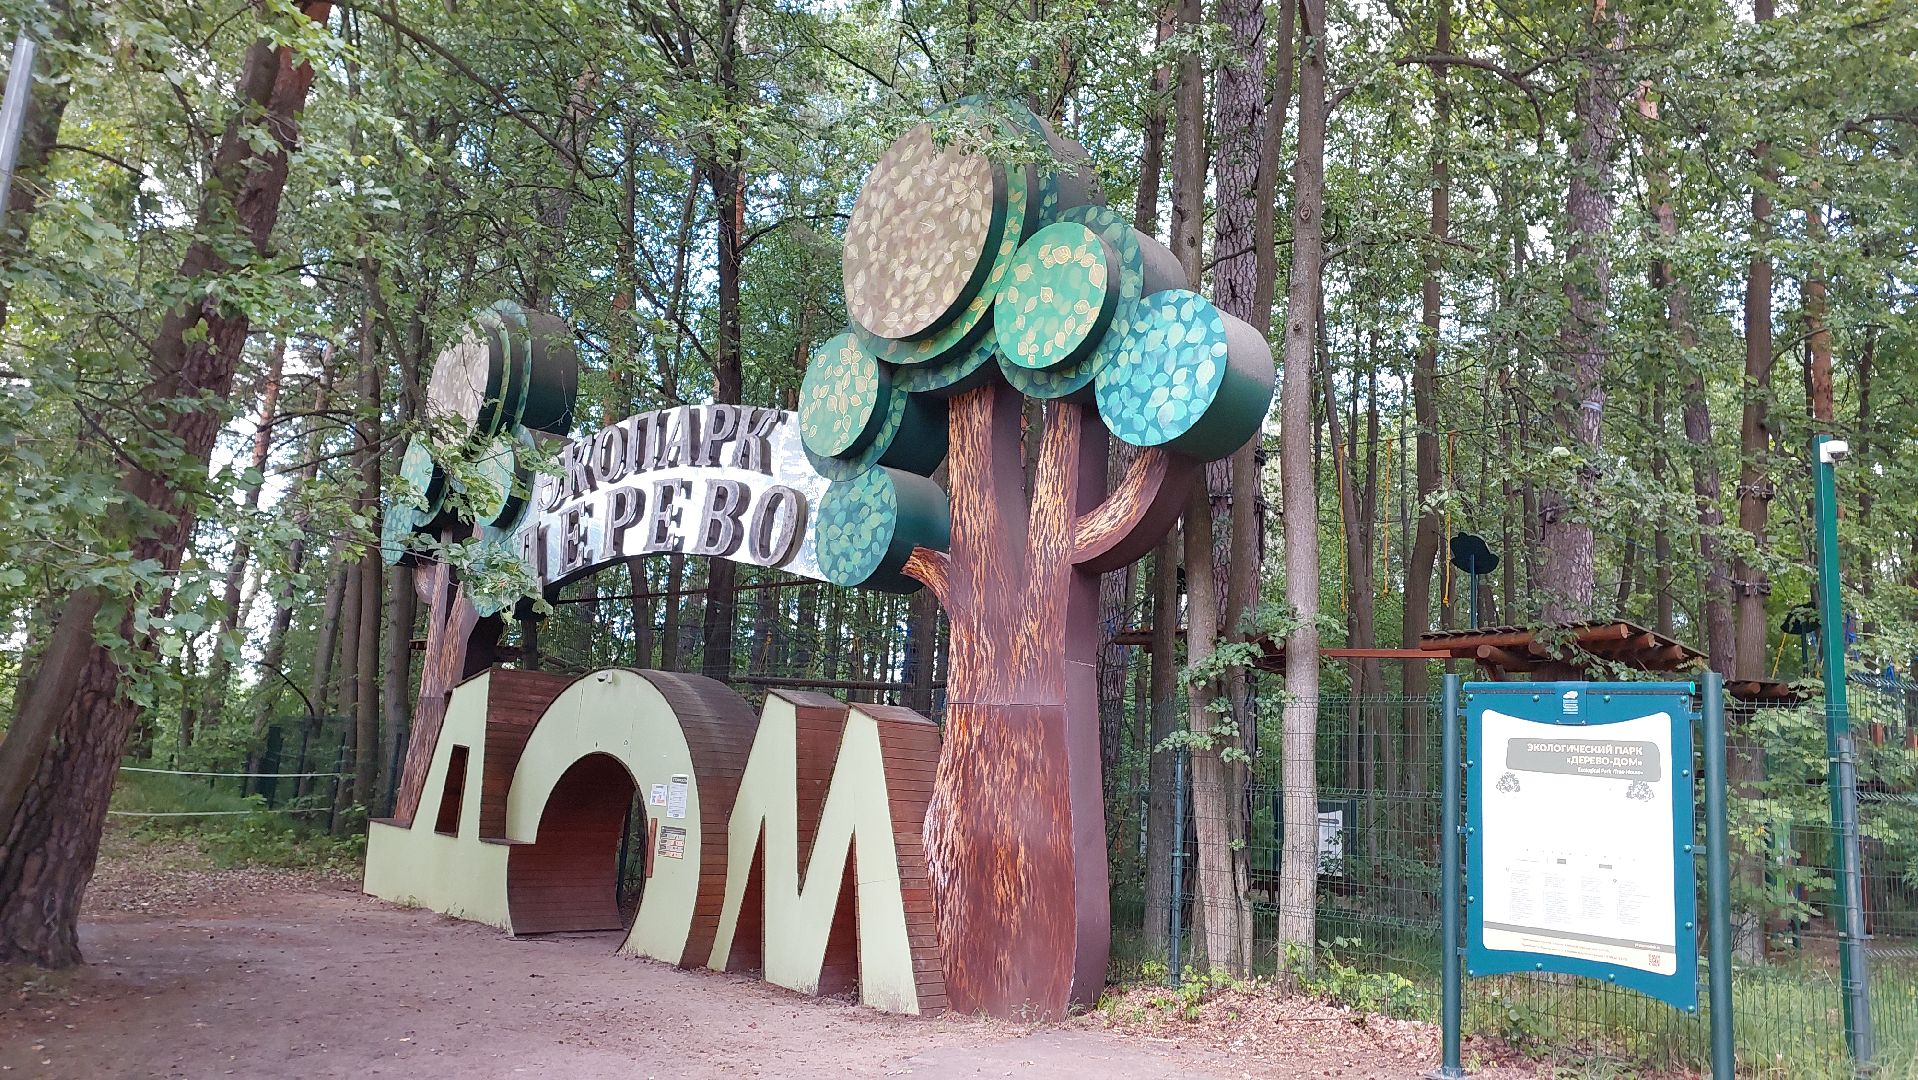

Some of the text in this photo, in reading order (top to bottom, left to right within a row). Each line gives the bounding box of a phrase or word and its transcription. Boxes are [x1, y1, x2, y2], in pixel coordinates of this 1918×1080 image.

[1527, 743, 1643, 756] ЭКОЛОГИЧЕСКИЙ ПАРК
[1566, 755, 1643, 767] «ДЕРЕВО-ДОМ»
[362, 667, 922, 1016] ДОМ
